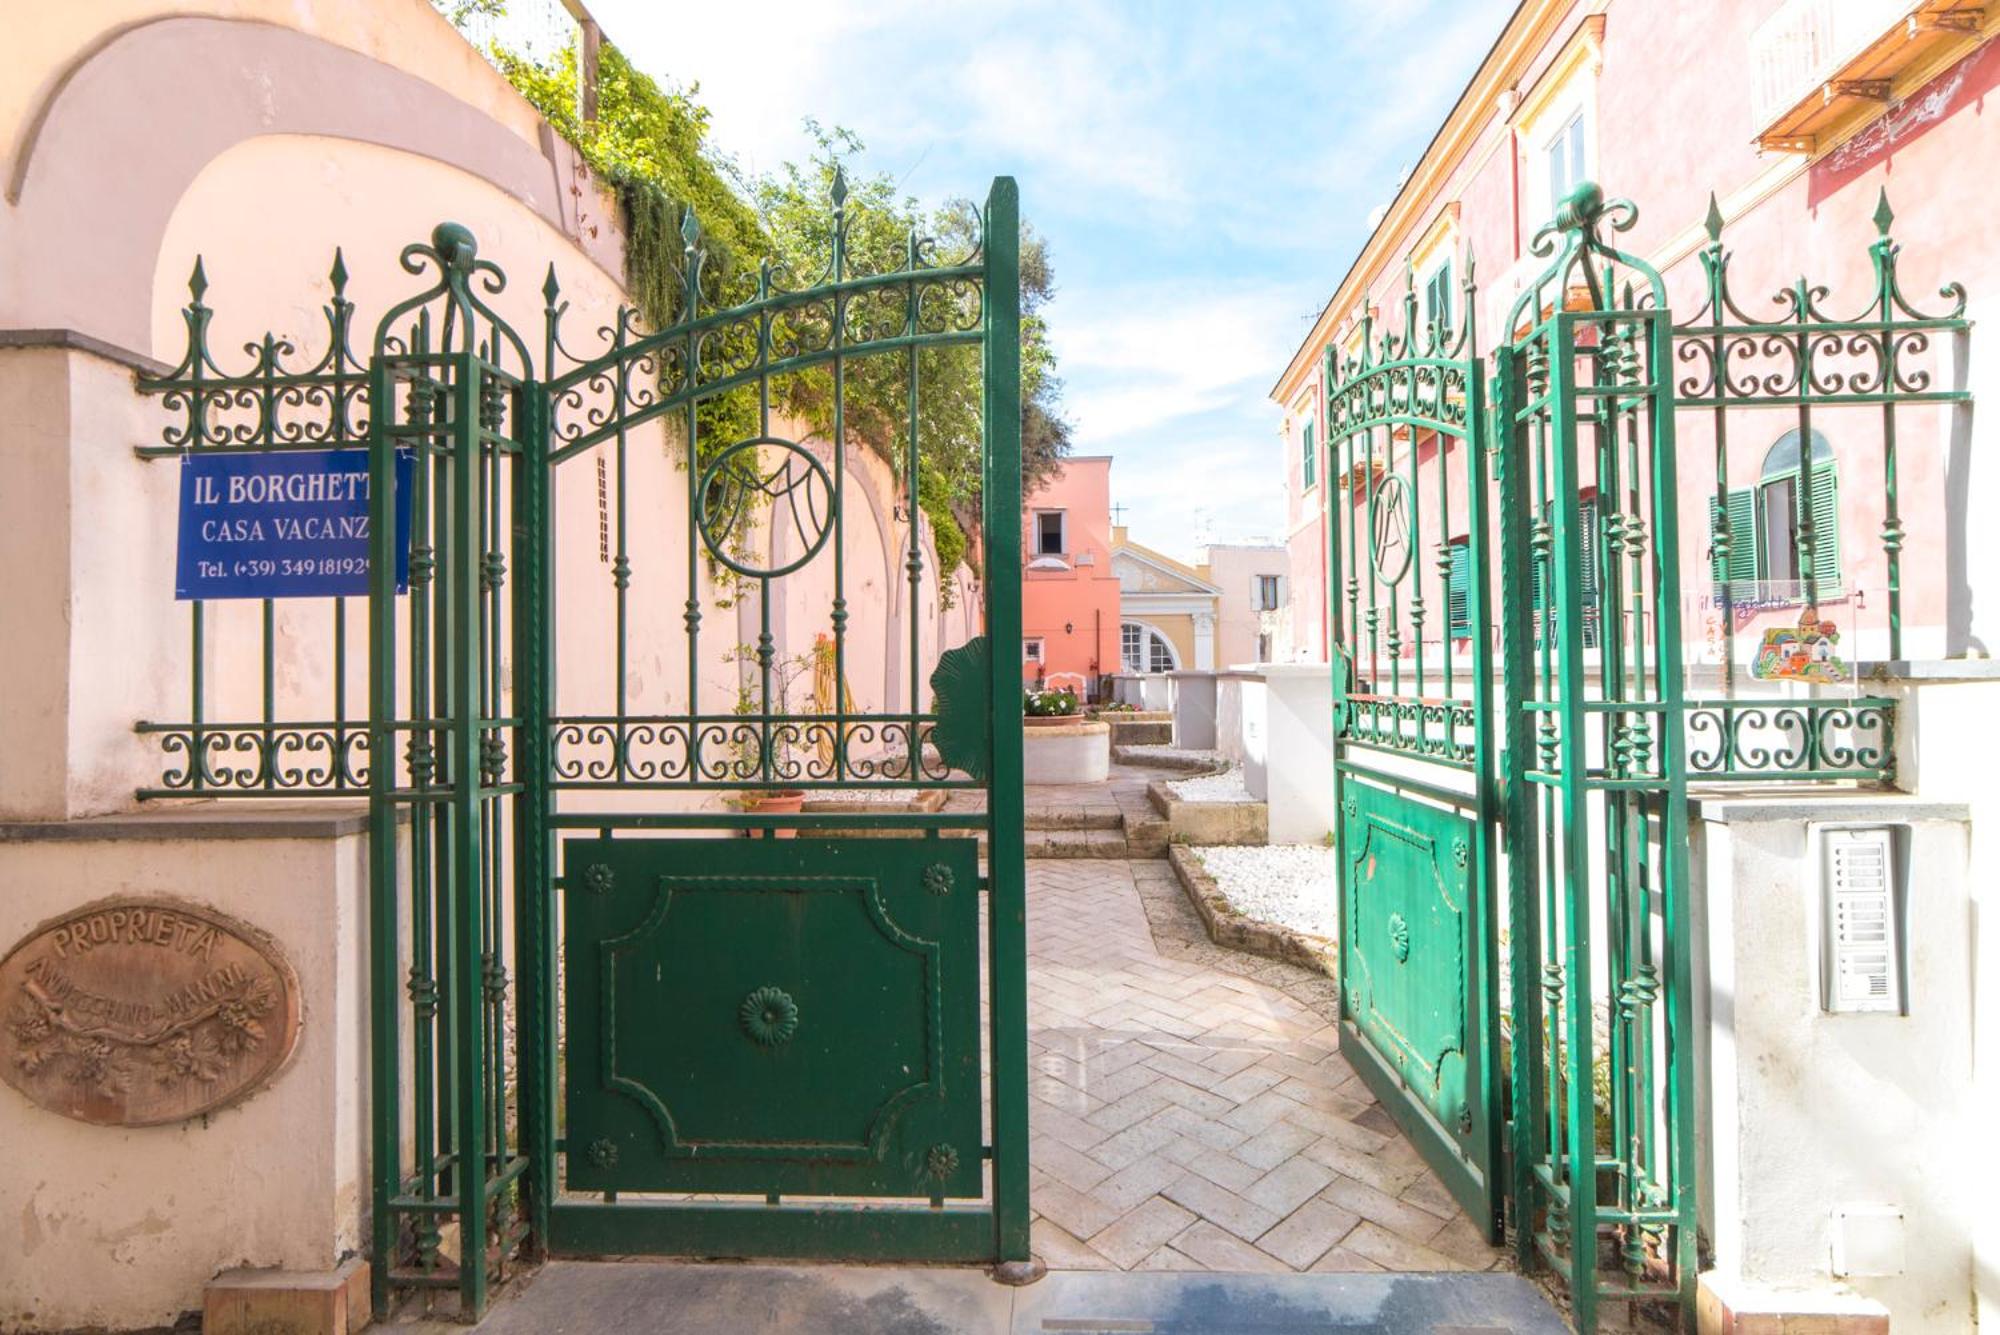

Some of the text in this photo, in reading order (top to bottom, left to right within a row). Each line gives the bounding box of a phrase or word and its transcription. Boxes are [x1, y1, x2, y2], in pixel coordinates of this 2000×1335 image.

[194, 473, 397, 504] IL BORGHETT
[202, 516, 370, 542] CASA VACANZ
[198, 561, 228, 578] Tel.
[234, 560, 276, 577] (+39)
